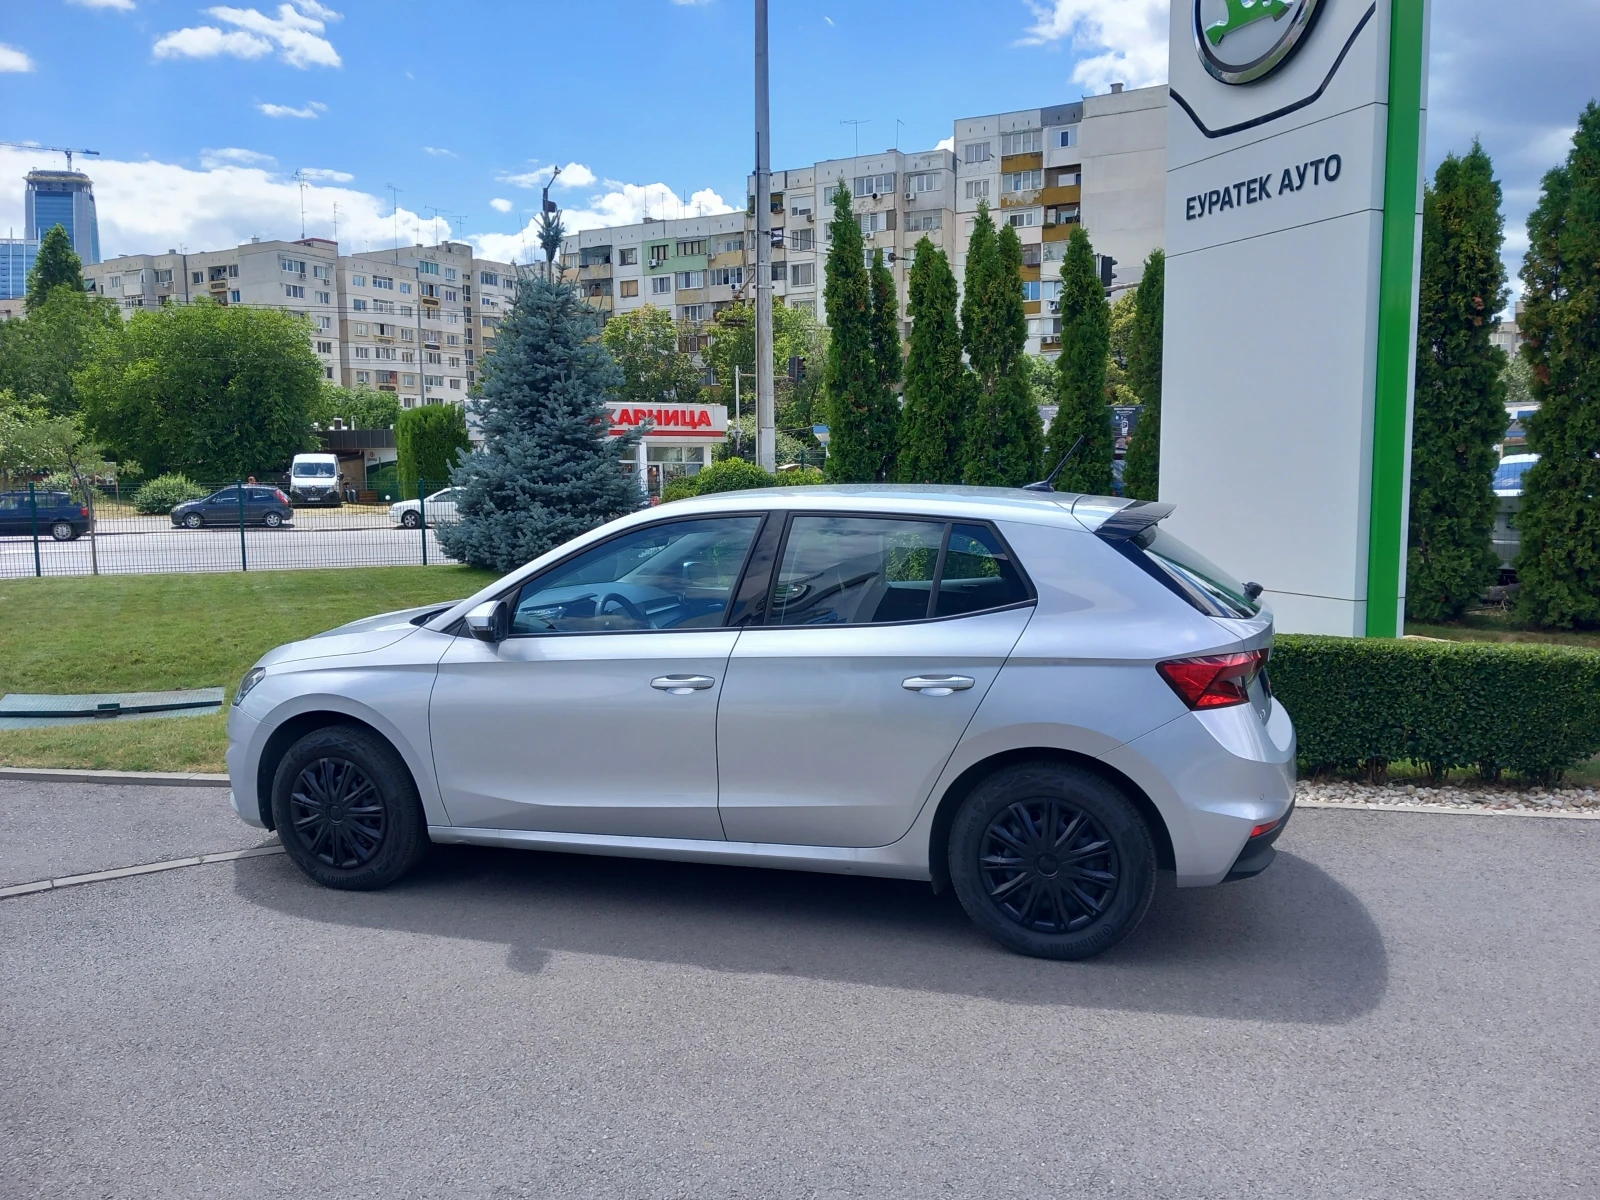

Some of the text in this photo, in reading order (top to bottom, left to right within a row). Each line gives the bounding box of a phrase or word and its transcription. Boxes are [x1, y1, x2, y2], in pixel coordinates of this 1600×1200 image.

[1186, 153, 1342, 221] ЕУРАТЕК АУТО
[595, 408, 712, 429] КАРНИЦА
